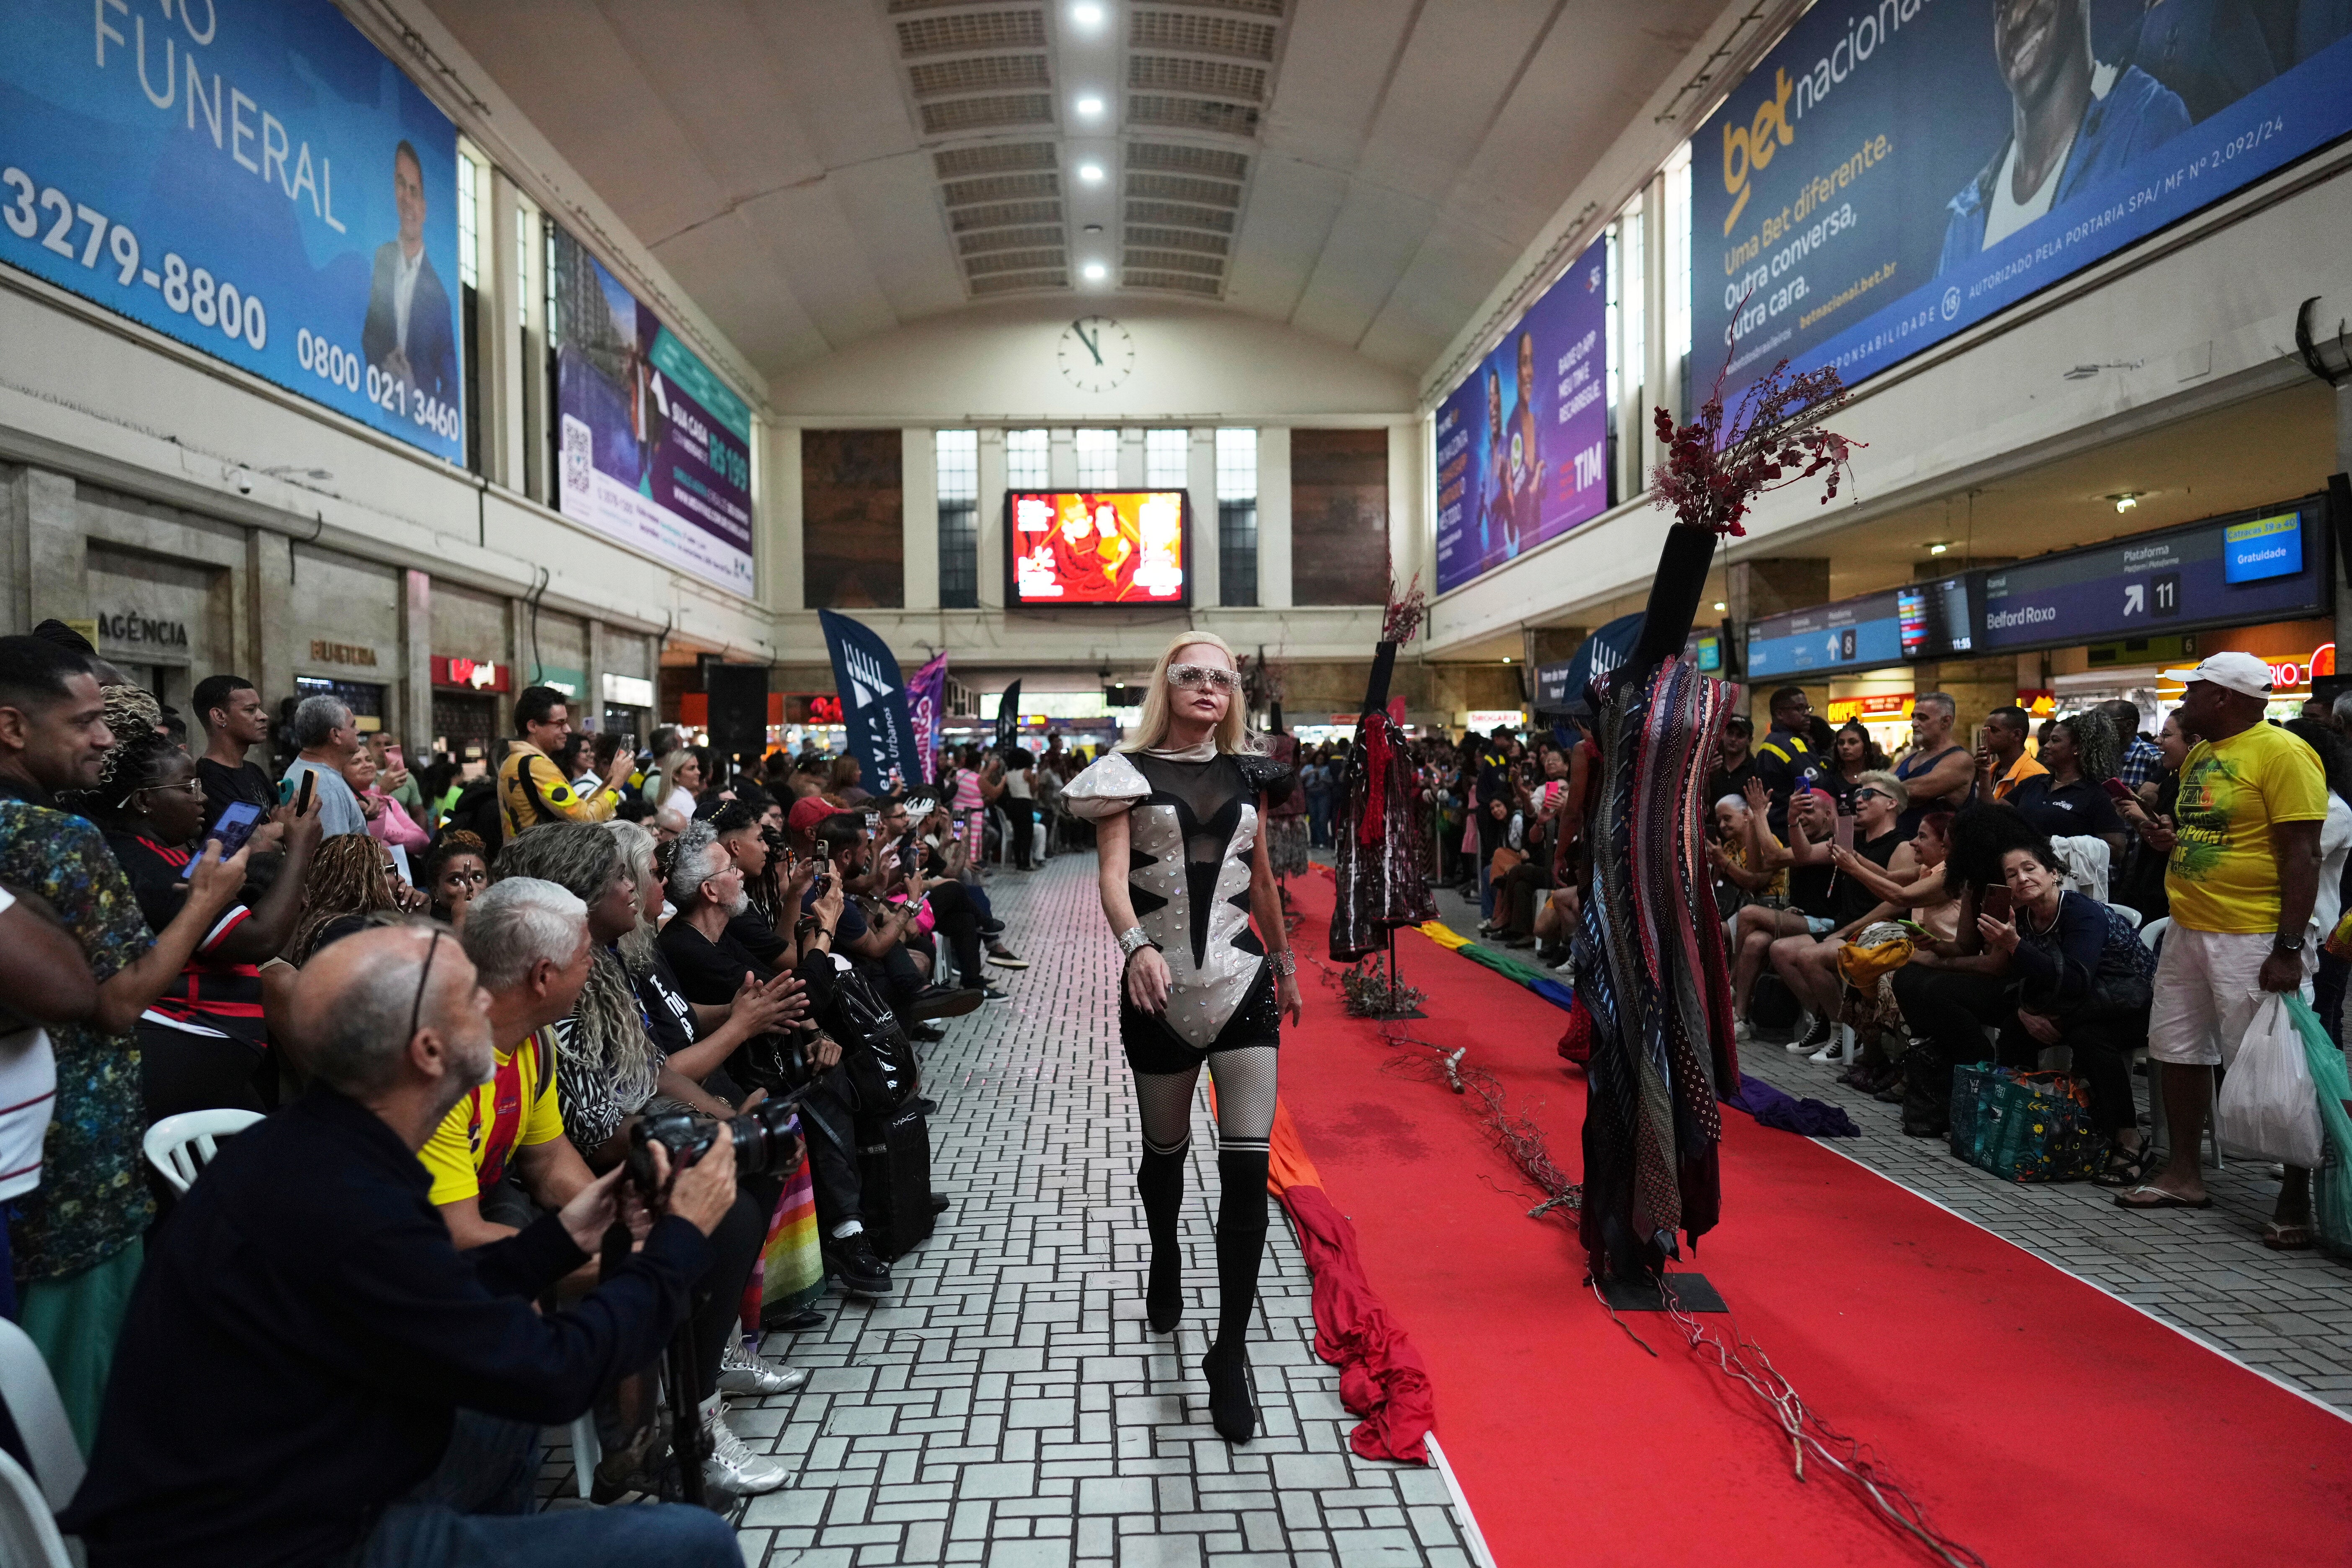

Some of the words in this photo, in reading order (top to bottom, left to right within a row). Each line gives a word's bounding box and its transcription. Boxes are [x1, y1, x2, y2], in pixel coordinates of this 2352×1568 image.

[95, 0, 346, 234] FUNERAL
[1723, 67, 1794, 194] bet
[1725, 235, 1759, 276] Uma
[1762, 206, 1791, 248] Bet
[1794, 134, 1893, 222] diferente.
[1968, 255, 2032, 300] AUTORIZADO
[2035, 240, 2063, 265] PELA
[2065, 203, 2125, 247] PORTARIA
[2129, 180, 2161, 213] SPA/
[2165, 170, 2184, 194] MF
[2212, 116, 2284, 169] 2.092/24
[2, 166, 267, 351] 3279-8800
[1725, 263, 1768, 311] Outra
[1771, 202, 1857, 278] conversa,
[1769, 276, 1810, 317] cara.
[1800, 260, 1897, 330] betnacional.bet.br
[297, 328, 360, 393] 0800
[366, 364, 406, 417] 021
[413, 389, 459, 442] 3460
[1574, 441, 1602, 493] TIM
[2123, 544, 2170, 563] Plataforma
[2237, 547, 2287, 565] Gratuidade
[1986, 608, 2025, 630] Belford
[2026, 606, 2056, 624] Roxo
[2156, 581, 2174, 609] 11
[1844, 635, 1852, 655] 8
[2185, 638, 2193, 652] 6
[883, 707, 900, 758] Urbanos
